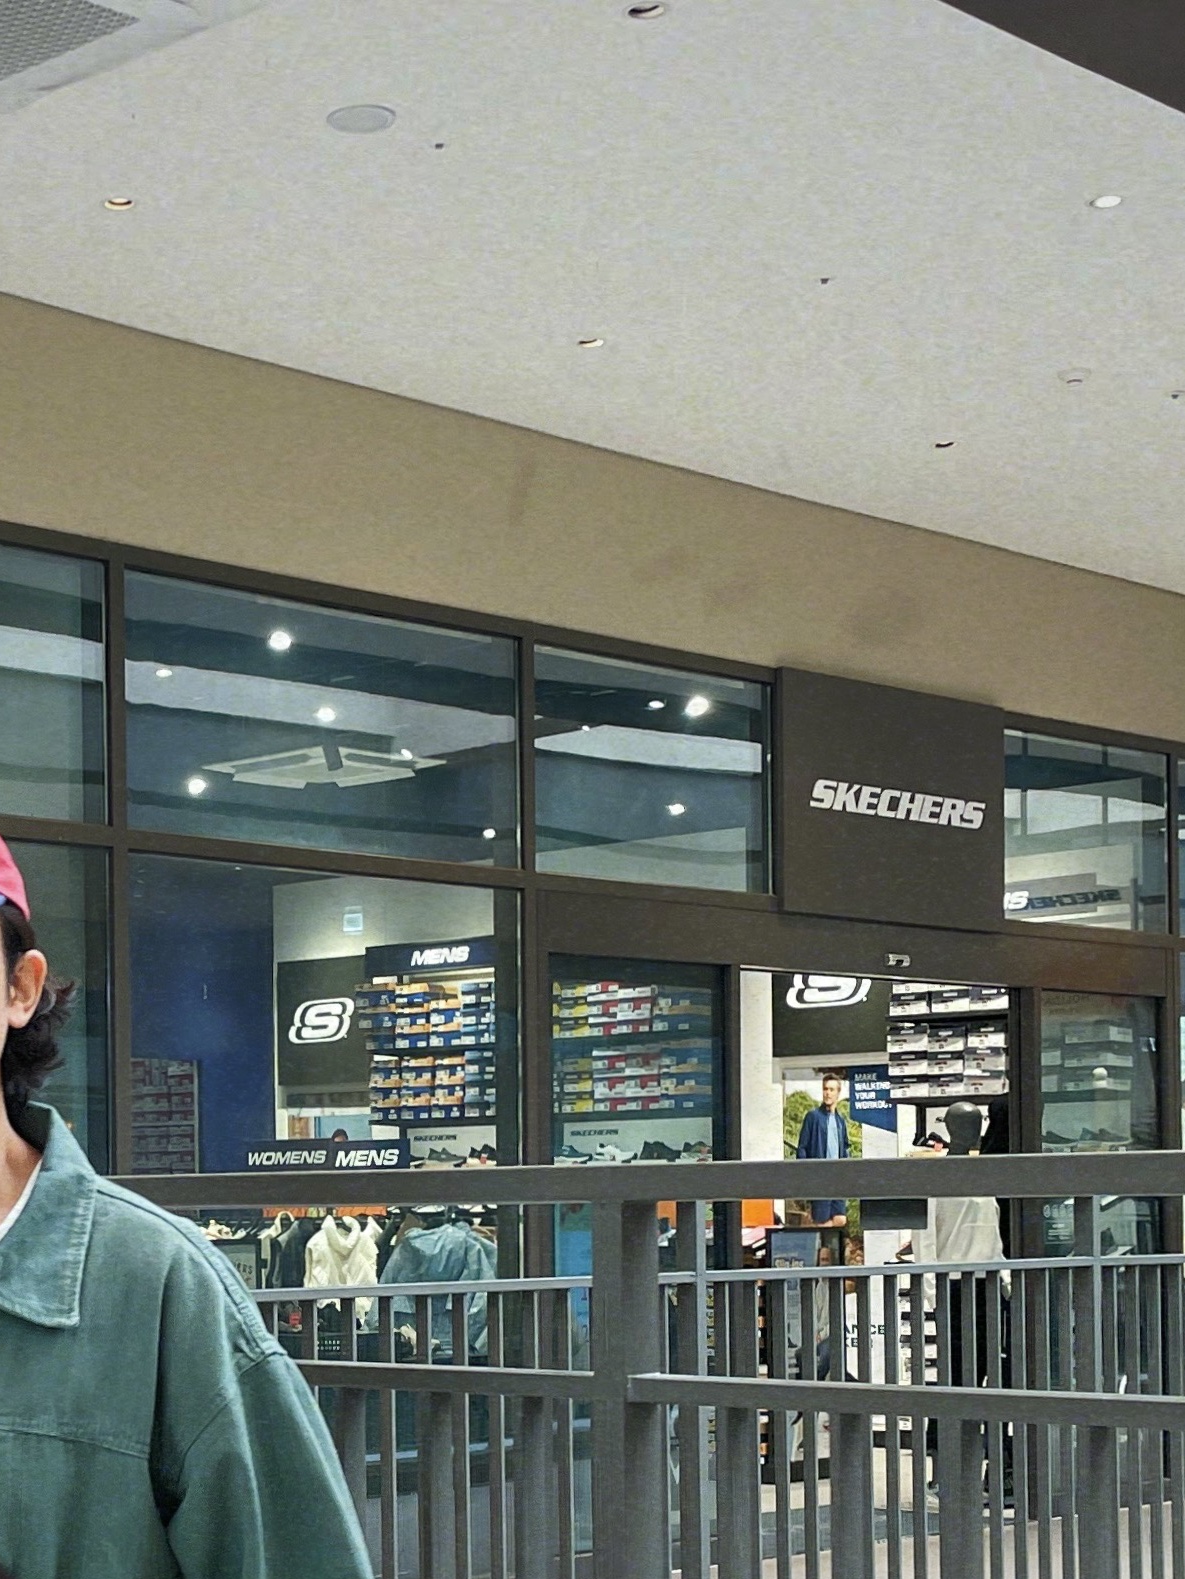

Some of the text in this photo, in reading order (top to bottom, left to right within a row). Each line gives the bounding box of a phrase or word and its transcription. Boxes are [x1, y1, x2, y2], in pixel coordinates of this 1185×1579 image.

[810, 779, 986, 829] SKECHERS
[410, 945, 470, 967] MENS
[413, 1133, 458, 1143] SKECHERS
[570, 1127, 620, 1137] SKECHERS
[247, 1148, 400, 1168] WOMENS MENS
